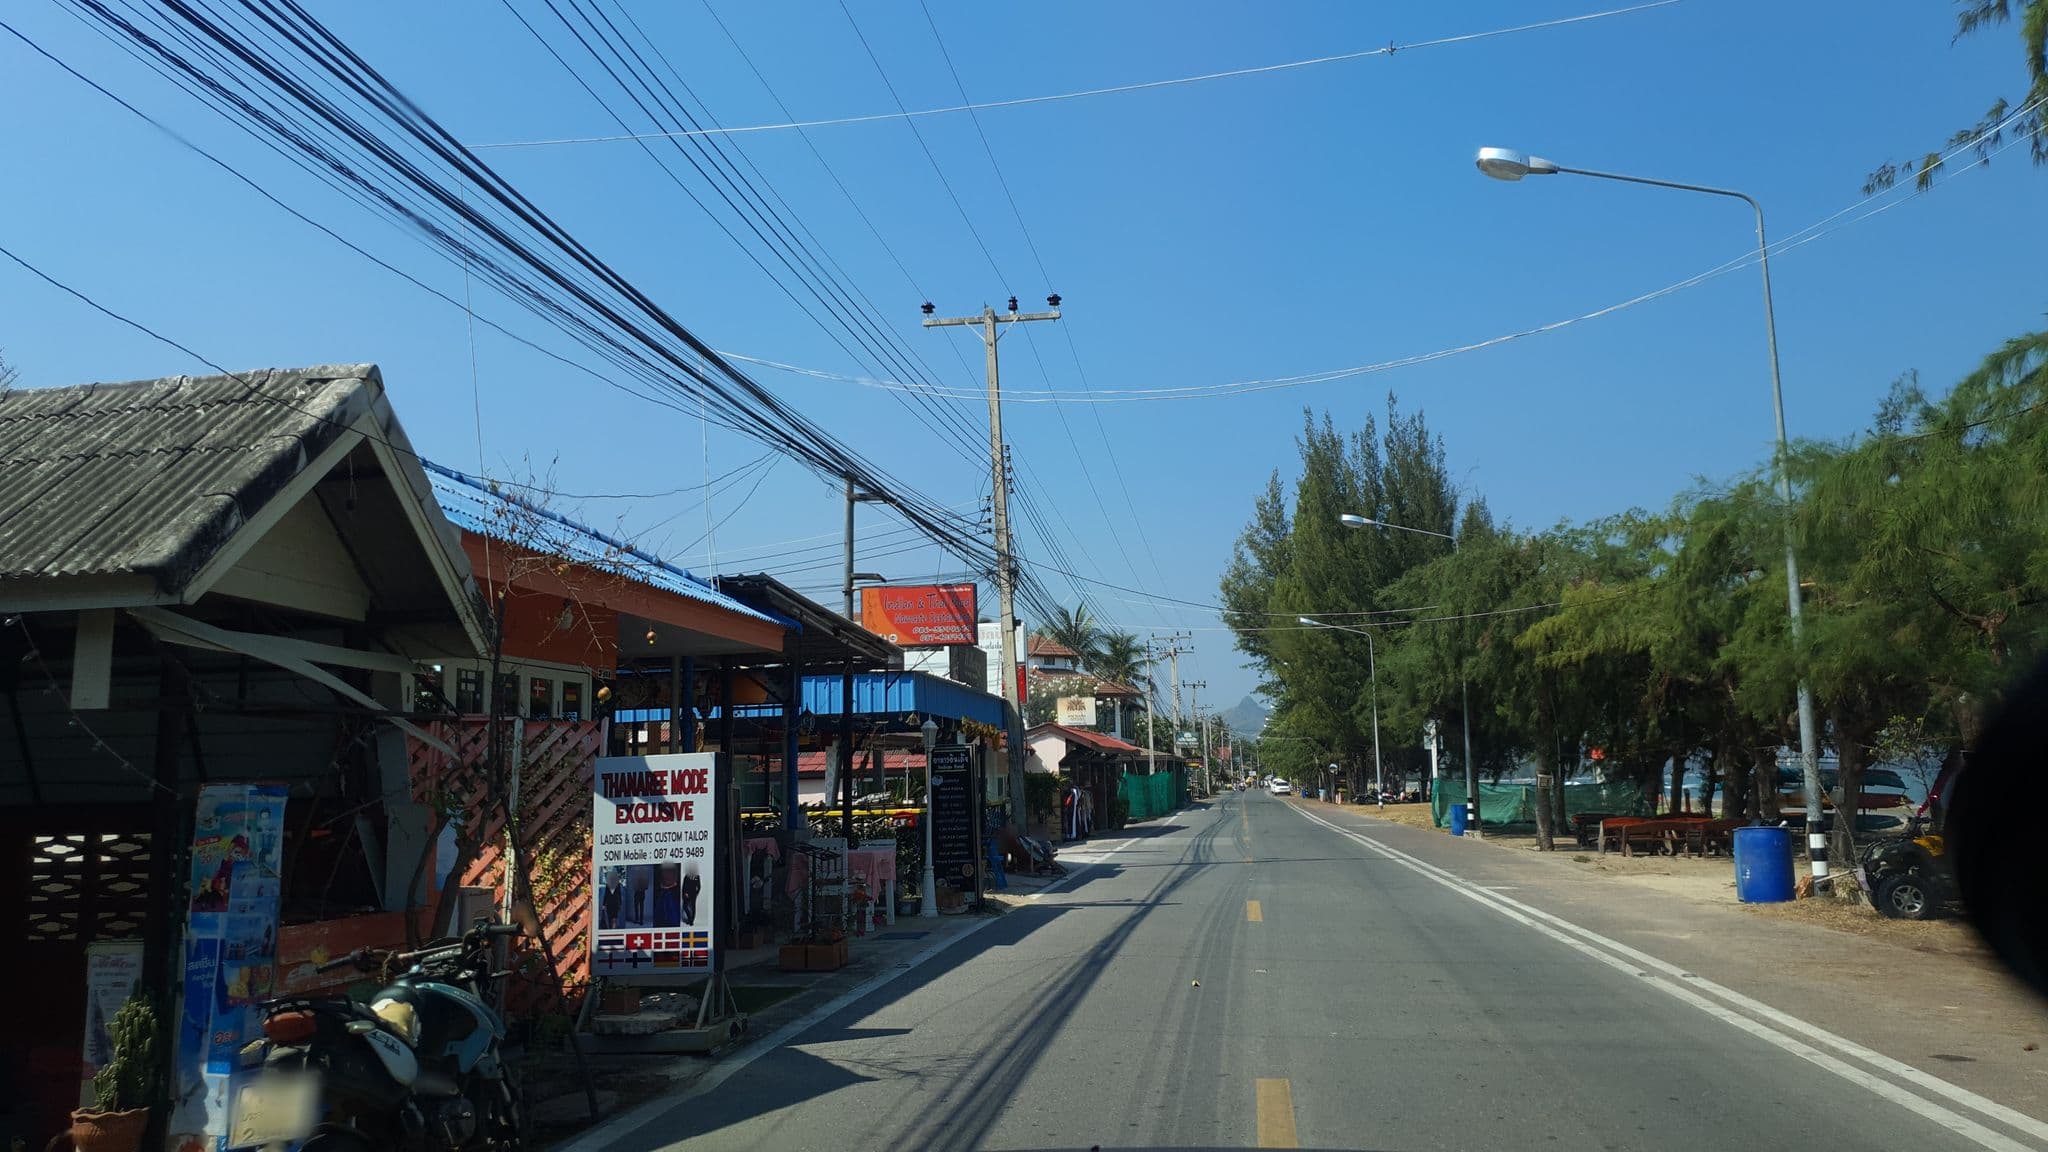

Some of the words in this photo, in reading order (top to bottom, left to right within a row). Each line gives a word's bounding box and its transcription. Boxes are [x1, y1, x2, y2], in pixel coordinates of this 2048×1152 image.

[601, 770, 668, 798] THANAREE
[671, 768, 708, 795] MODE
[616, 801, 694, 824] EXCLUSIVE
[600, 832, 623, 846] LADIES
[624, 832, 630, 844] &
[632, 832, 653, 844] GENTS
[654, 831, 683, 844] CUSTOM
[684, 830, 708, 842] TAILOR
[604, 850, 621, 861] SONI
[623, 848, 648, 861] Mobile
[653, 847, 668, 859] 087
[669, 847, 684, 858] 405
[686, 846, 705, 858] 9489
